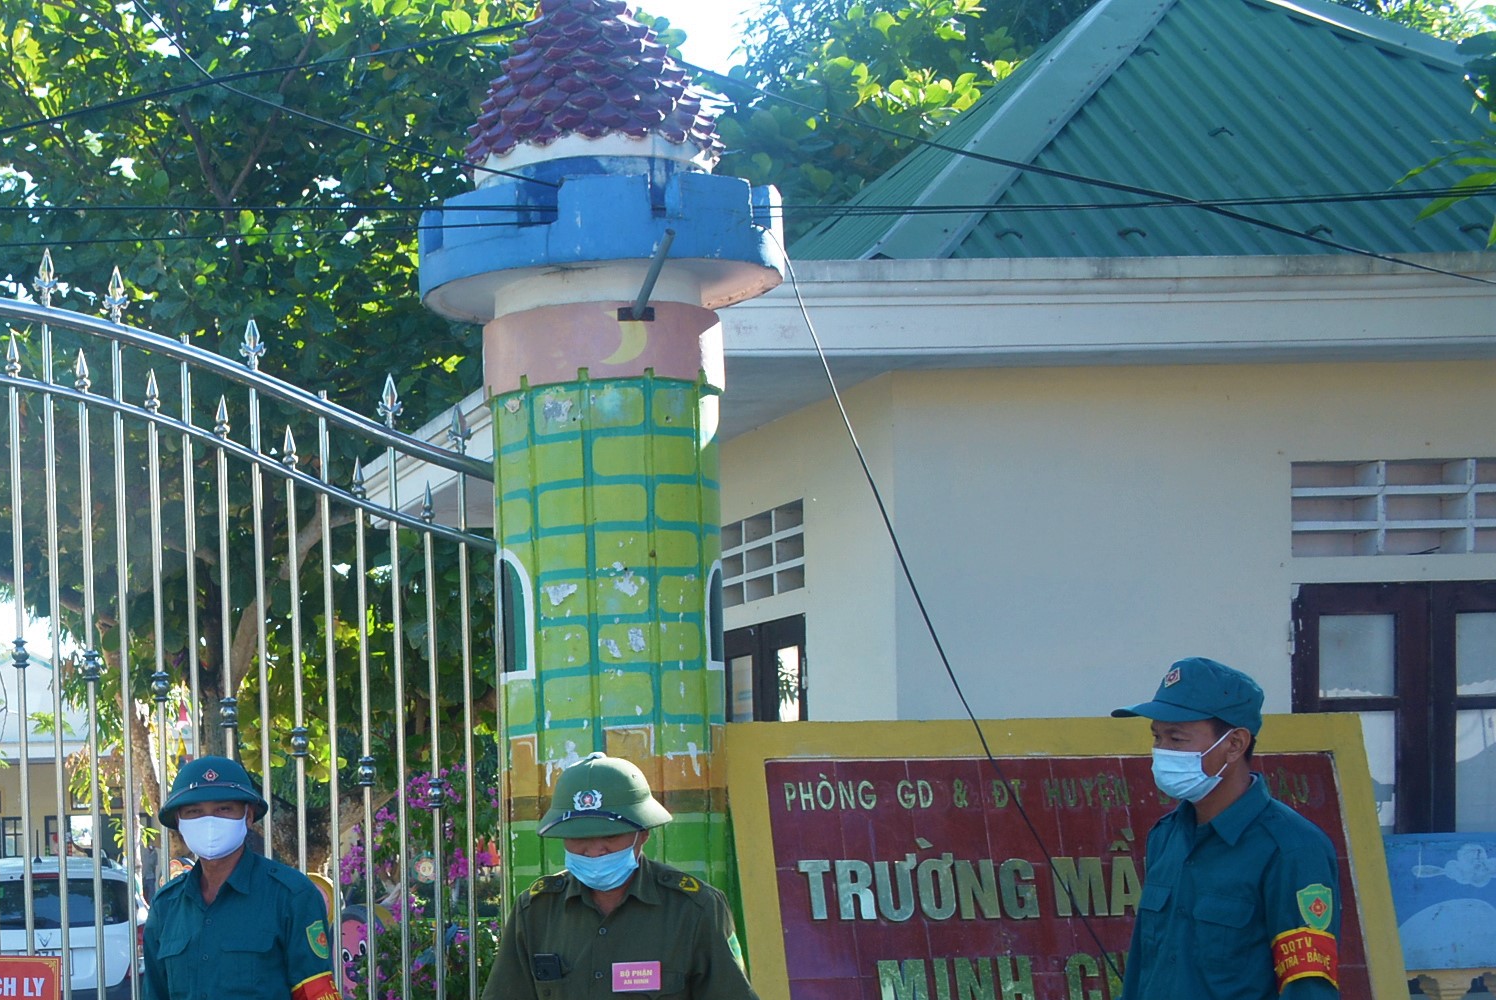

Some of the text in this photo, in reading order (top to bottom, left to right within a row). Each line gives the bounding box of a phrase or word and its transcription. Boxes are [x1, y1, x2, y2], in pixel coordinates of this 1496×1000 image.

[784, 773, 877, 811] PHÒNG
[897, 780, 933, 809] GD
[954, 778, 968, 808] &
[1045, 773, 1131, 810] HUYỆN
[798, 828, 1146, 921] TRƯỜNG MẦ
[23, 977, 45, 997] LY
